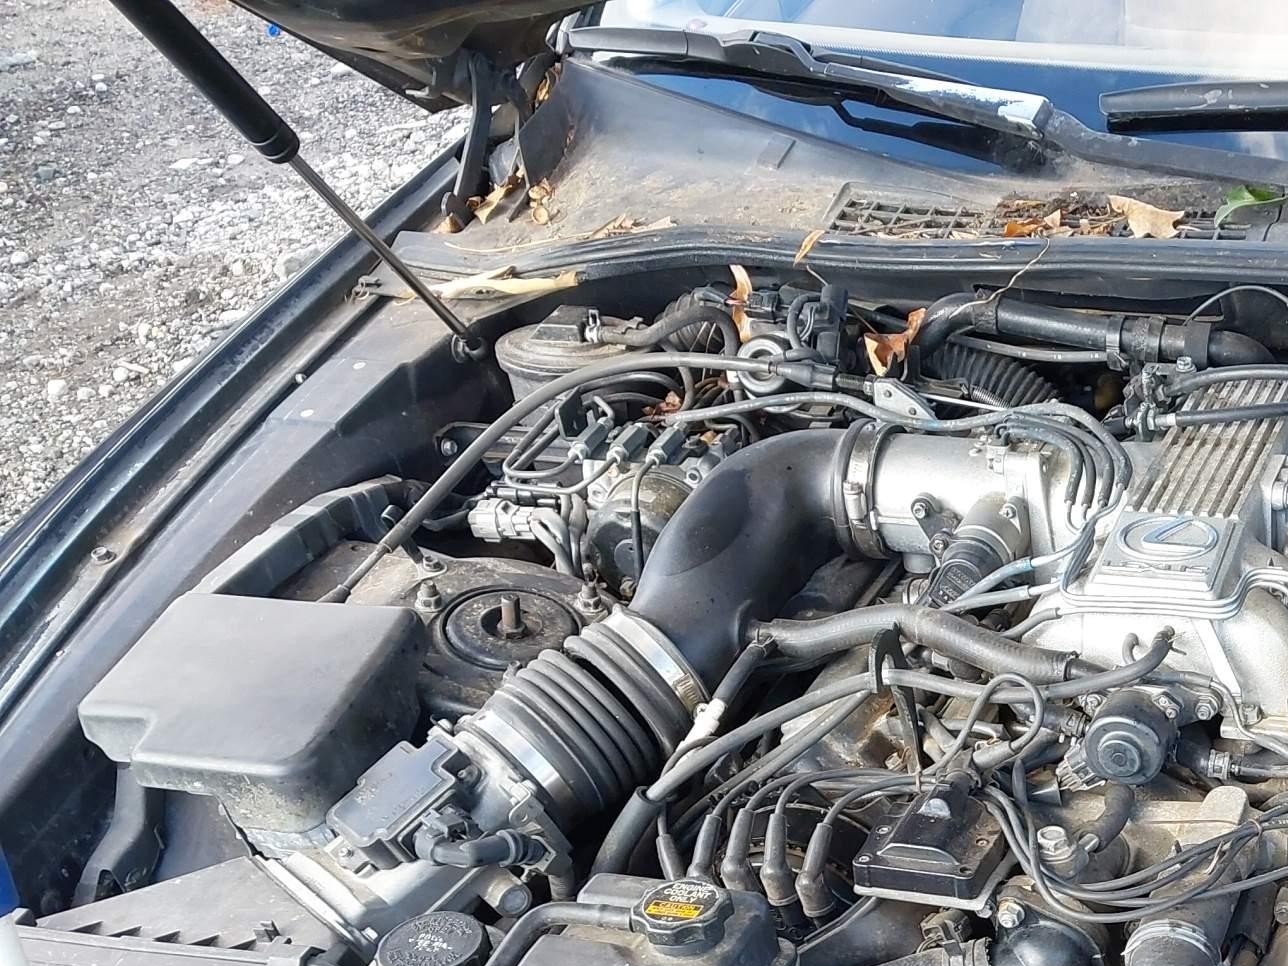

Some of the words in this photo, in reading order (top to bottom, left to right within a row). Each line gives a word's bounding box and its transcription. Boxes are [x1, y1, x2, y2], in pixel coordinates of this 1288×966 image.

[672, 882, 713, 892] ENGINE
[663, 888, 712, 899] COOLANT
[669, 895, 697, 904] ONLY
